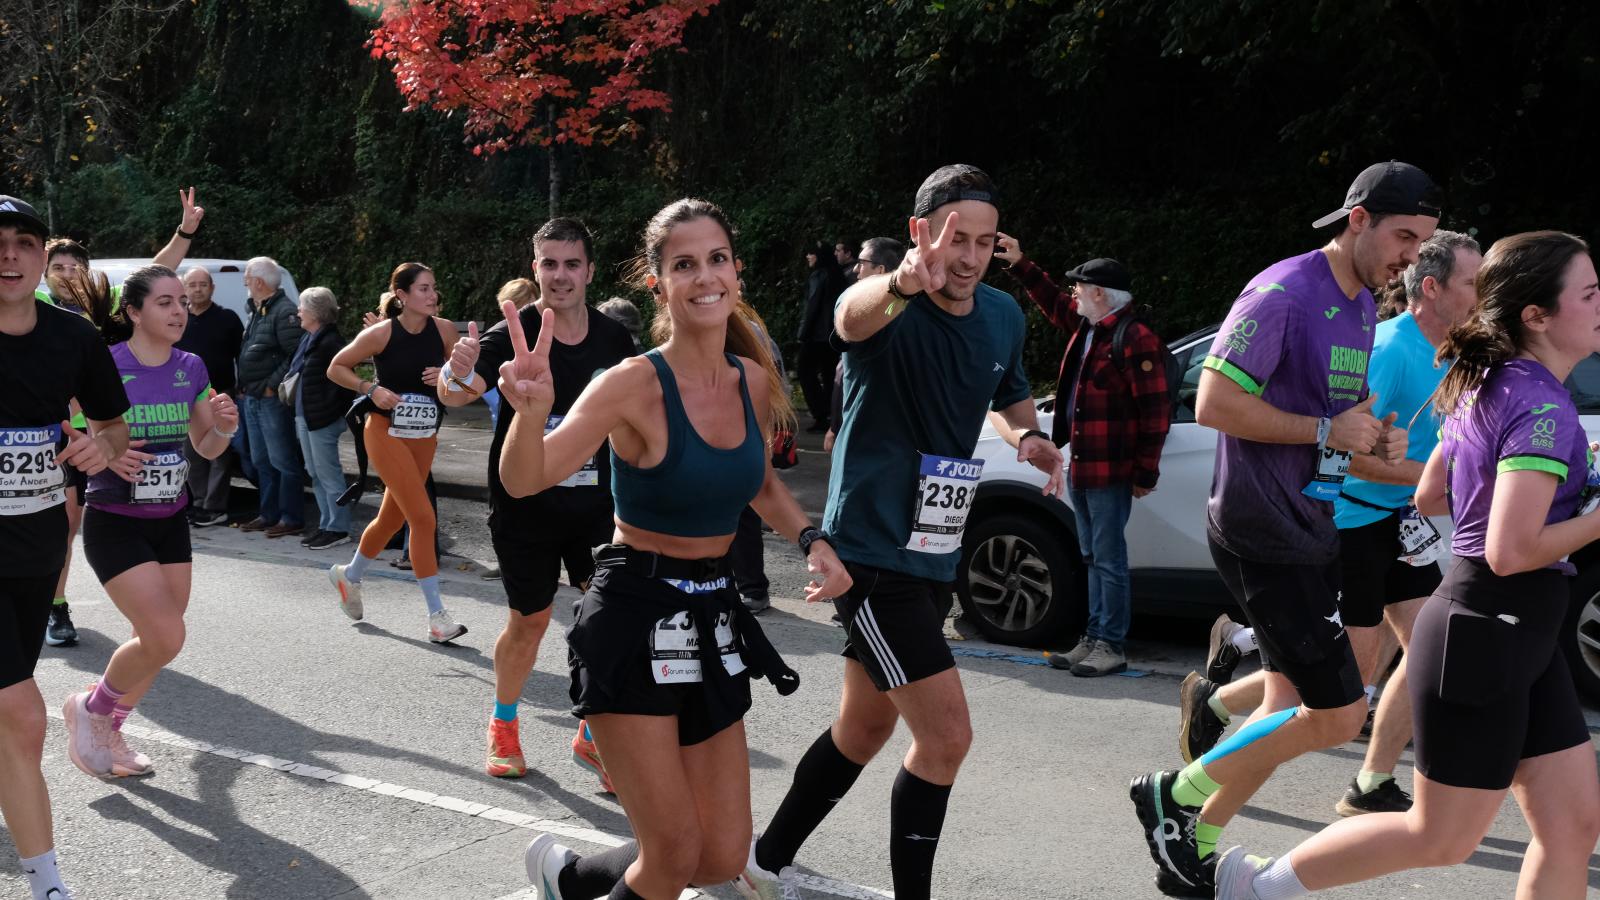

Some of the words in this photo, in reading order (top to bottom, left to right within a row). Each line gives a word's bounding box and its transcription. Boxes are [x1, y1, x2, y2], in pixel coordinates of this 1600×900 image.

[1233, 316, 1258, 337] 60
[1330, 345, 1368, 374] BEHOBI
[396, 405, 436, 418] 22753
[128, 426, 146, 437] AN
[1533, 418, 1556, 435] 60
[1532, 438, 1554, 449] B/SS
[0, 450, 57, 475] 6293
